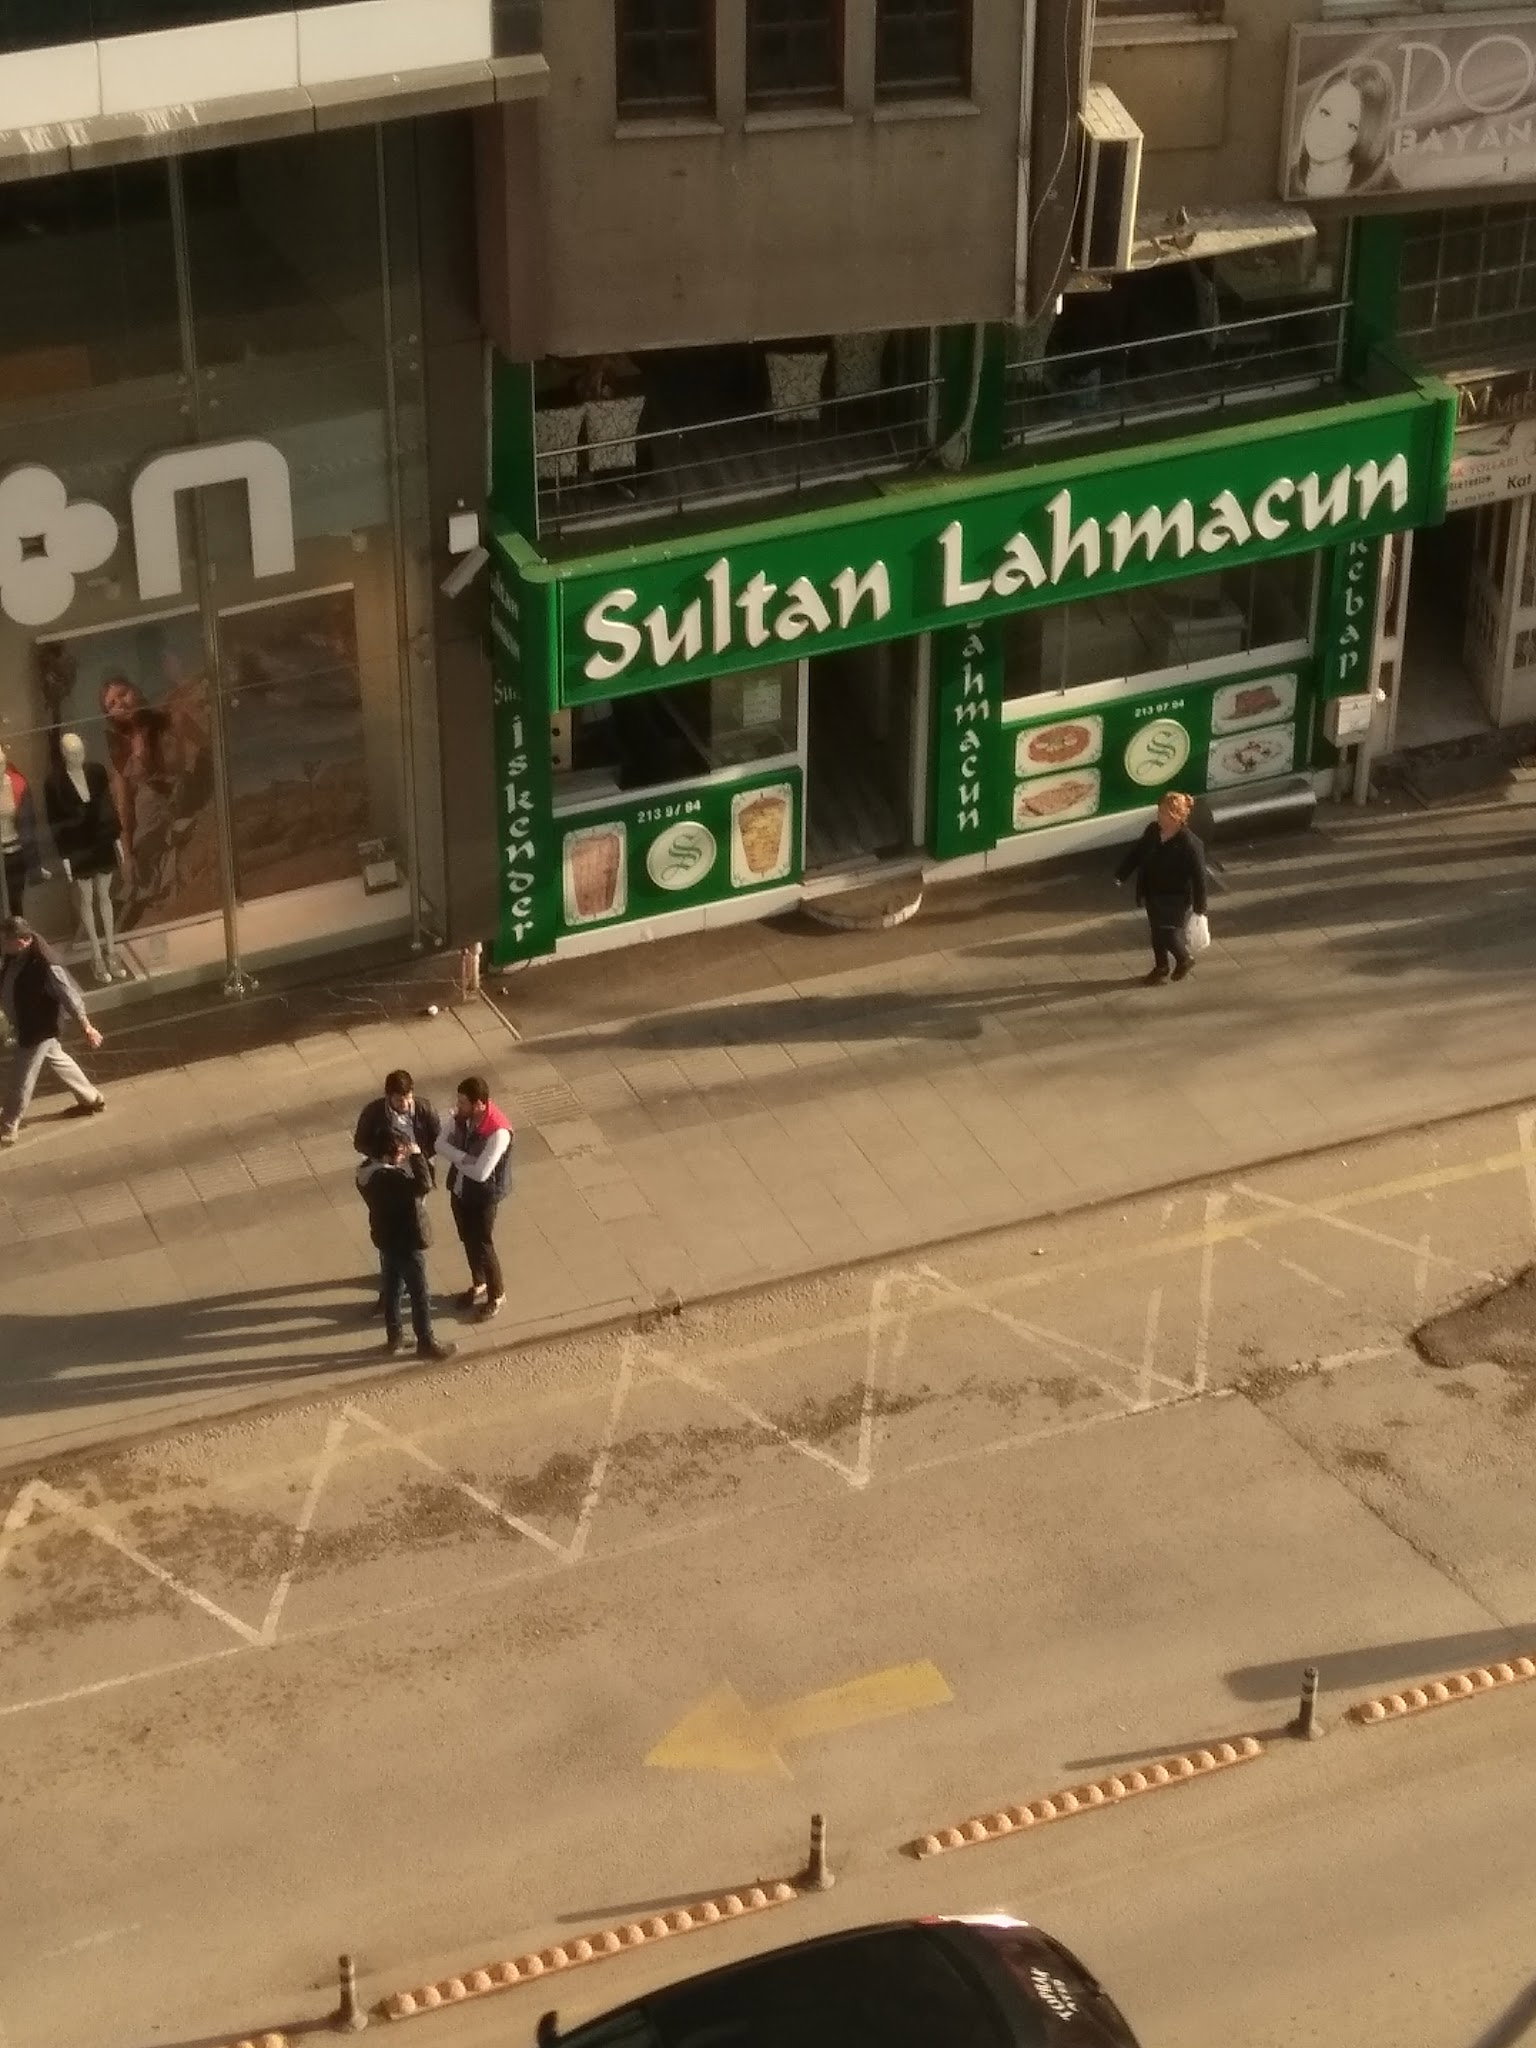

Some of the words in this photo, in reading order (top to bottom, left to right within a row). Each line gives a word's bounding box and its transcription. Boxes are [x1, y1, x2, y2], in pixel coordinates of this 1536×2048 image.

[584, 557, 891, 681] Sultan
[938, 453, 1408, 607] Lahmacun
[637, 808, 662, 824] 213
[954, 621, 990, 832] ahmacun
